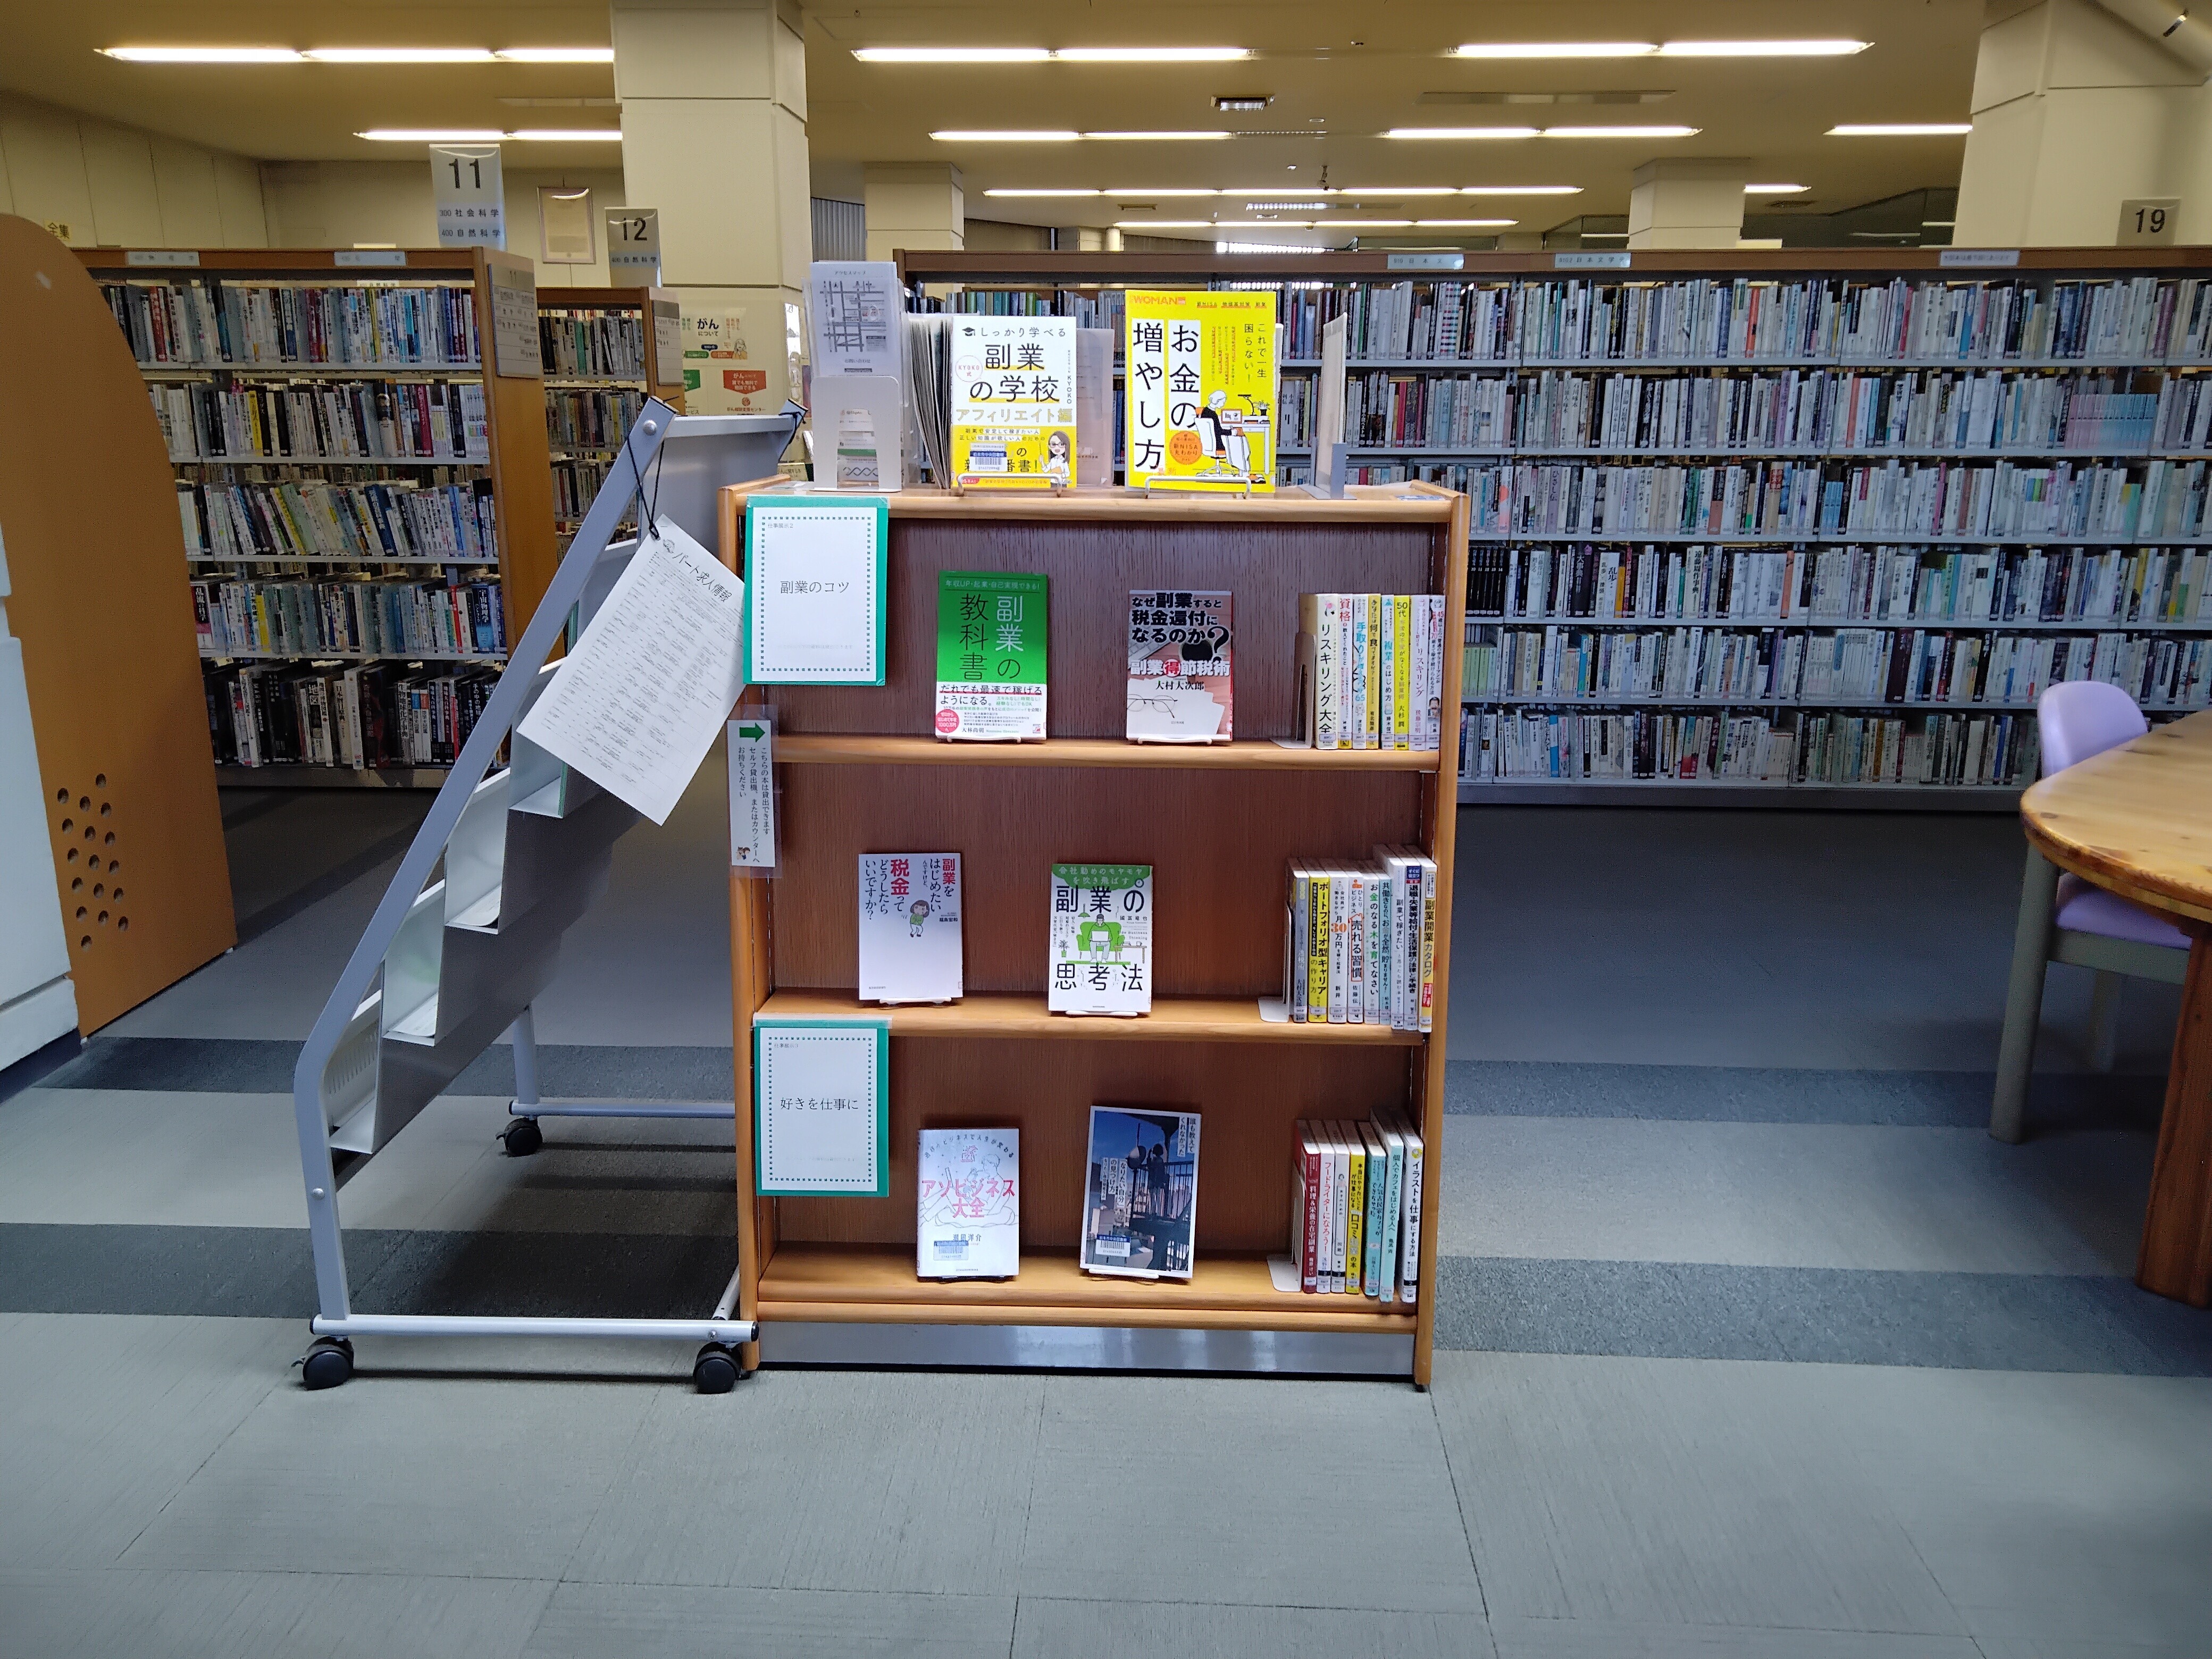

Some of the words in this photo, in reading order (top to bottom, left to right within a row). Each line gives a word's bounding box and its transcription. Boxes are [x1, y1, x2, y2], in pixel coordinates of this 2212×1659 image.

[449, 158, 481, 189] 11
[455, 209, 499, 217] 社会科学
[623, 216, 647, 241] 12
[2135, 208, 2166, 233] 19
[457, 229, 501, 238] 自然科学
[1134, 296, 1177, 305] WOMAN
[697, 318, 719, 330] がん
[981, 327, 1066, 338] しっかり学べる
[985, 342, 1045, 370] 副業
[1257, 323, 1267, 378] これで一生
[969, 375, 1060, 403] の学校
[1169, 324, 1200, 429] お金の
[1133, 322, 1164, 470] 増やし方
[956, 408, 1073, 423] アフィリエイト編
[1017, 448, 1027, 457] の
[672, 551, 733, 604] パート求人情報
[780, 580, 850, 594] 副業のコツ
[479, 589, 489, 623] 宇宙物理学
[1132, 592, 1222, 608] なぜ副業すると
[1132, 610, 1218, 626] 税金還付に
[959, 593, 989, 681] 教科書
[995, 595, 1024, 680] 副業の
[1132, 626, 1229, 661] なるのか？
[1130, 659, 1230, 677] 副業得節税術
[1319, 624, 1333, 734] リスキリング大全
[941, 684, 1042, 695] だれでも最速で稼げる
[1155, 680, 1205, 690] 大村大次郎
[941, 696, 992, 706] ようになる。
[738, 747, 747, 797] お持ちください
[749, 747, 760, 863] セルフ貸出機、またはカウンターへ
[761, 747, 770, 835] こちらの本は貸出できます
[891, 859, 910, 911] 税金って
[930, 859, 941, 912] はじめたい
[943, 858, 956, 897] 副業を
[1059, 866, 1143, 875] 会社勤めのモヤモヤ
[1073, 876, 1130, 885] を吹き飛ばす
[865, 860, 877, 920] いいですか？
[879, 859, 890, 915] どうしたら
[1056, 885, 1145, 913] 副業の
[1318, 883, 1328, 995] ポートフォリオ型キャリア
[1352, 920, 1362, 978] 売れる習慣
[1370, 884, 1379, 995] お金のなる木を育てなさい
[1423, 900, 1435, 978] 副業開業カタログ
[1055, 963, 1143, 992] 思考法
[781, 1097, 859, 1111] 好きを仕事に
[922, 1178, 1015, 1197] アソビジネス
[1118, 1159, 1127, 1208] 「なりたい自分」
[1388, 1154, 1401, 1231] 個人でカフェをはじめる人へ
[952, 1197, 985, 1218] 大全
[1323, 1162, 1332, 1255] フードライターになろう！
[1410, 1161, 1420, 1256] イラストを仕事にする方法
